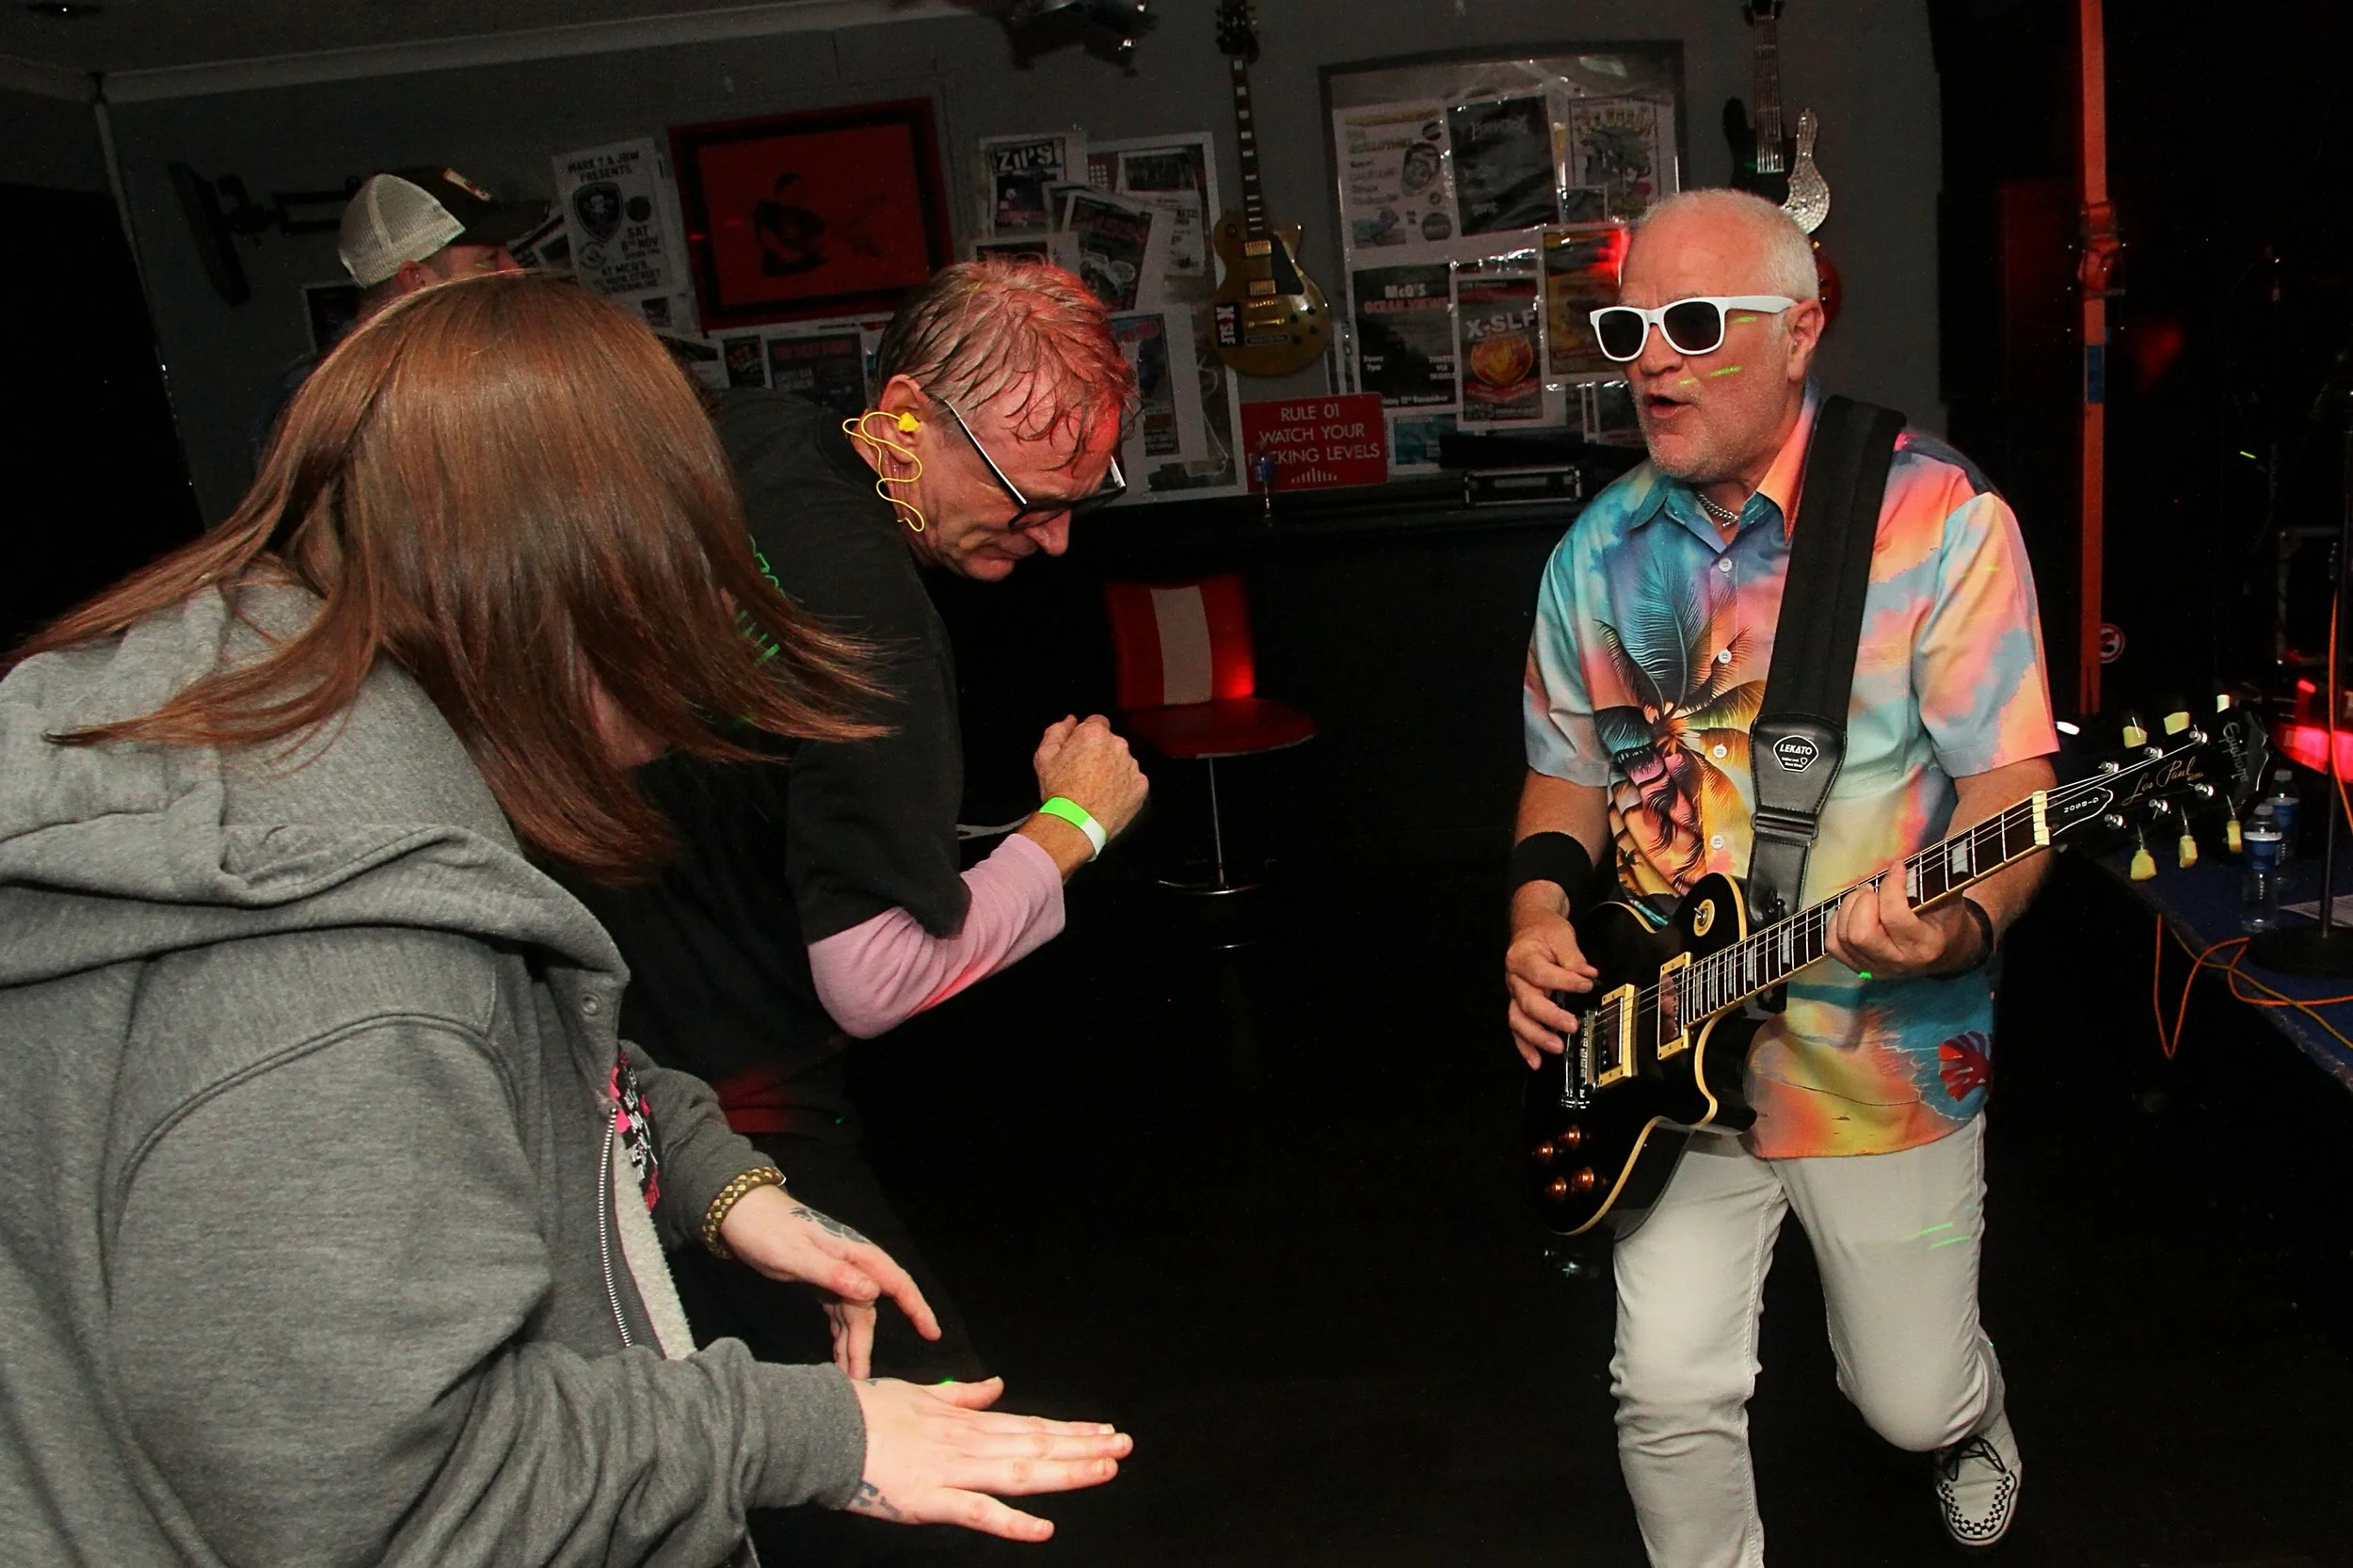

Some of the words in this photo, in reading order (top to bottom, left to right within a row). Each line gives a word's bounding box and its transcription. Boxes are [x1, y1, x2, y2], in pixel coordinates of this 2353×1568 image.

[568, 159, 595, 173] MARK
[580, 165, 632, 183] PRESENTS
[627, 225, 648, 237] SAT
[1465, 309, 1536, 339] X-SLF
[1280, 405, 1317, 423] RULE
[1323, 403, 1340, 419] 01
[1258, 426, 1314, 444] WATCH
[1321, 423, 1366, 440] YOUR
[1248, 447, 1320, 468] FCKING
[1326, 442, 1381, 461] LEVELS
[1779, 744, 1813, 756] LEKATO
[2217, 721, 2249, 783] Epiphone
[2121, 772, 2153, 807] Les
[2155, 756, 2197, 788] Paul
